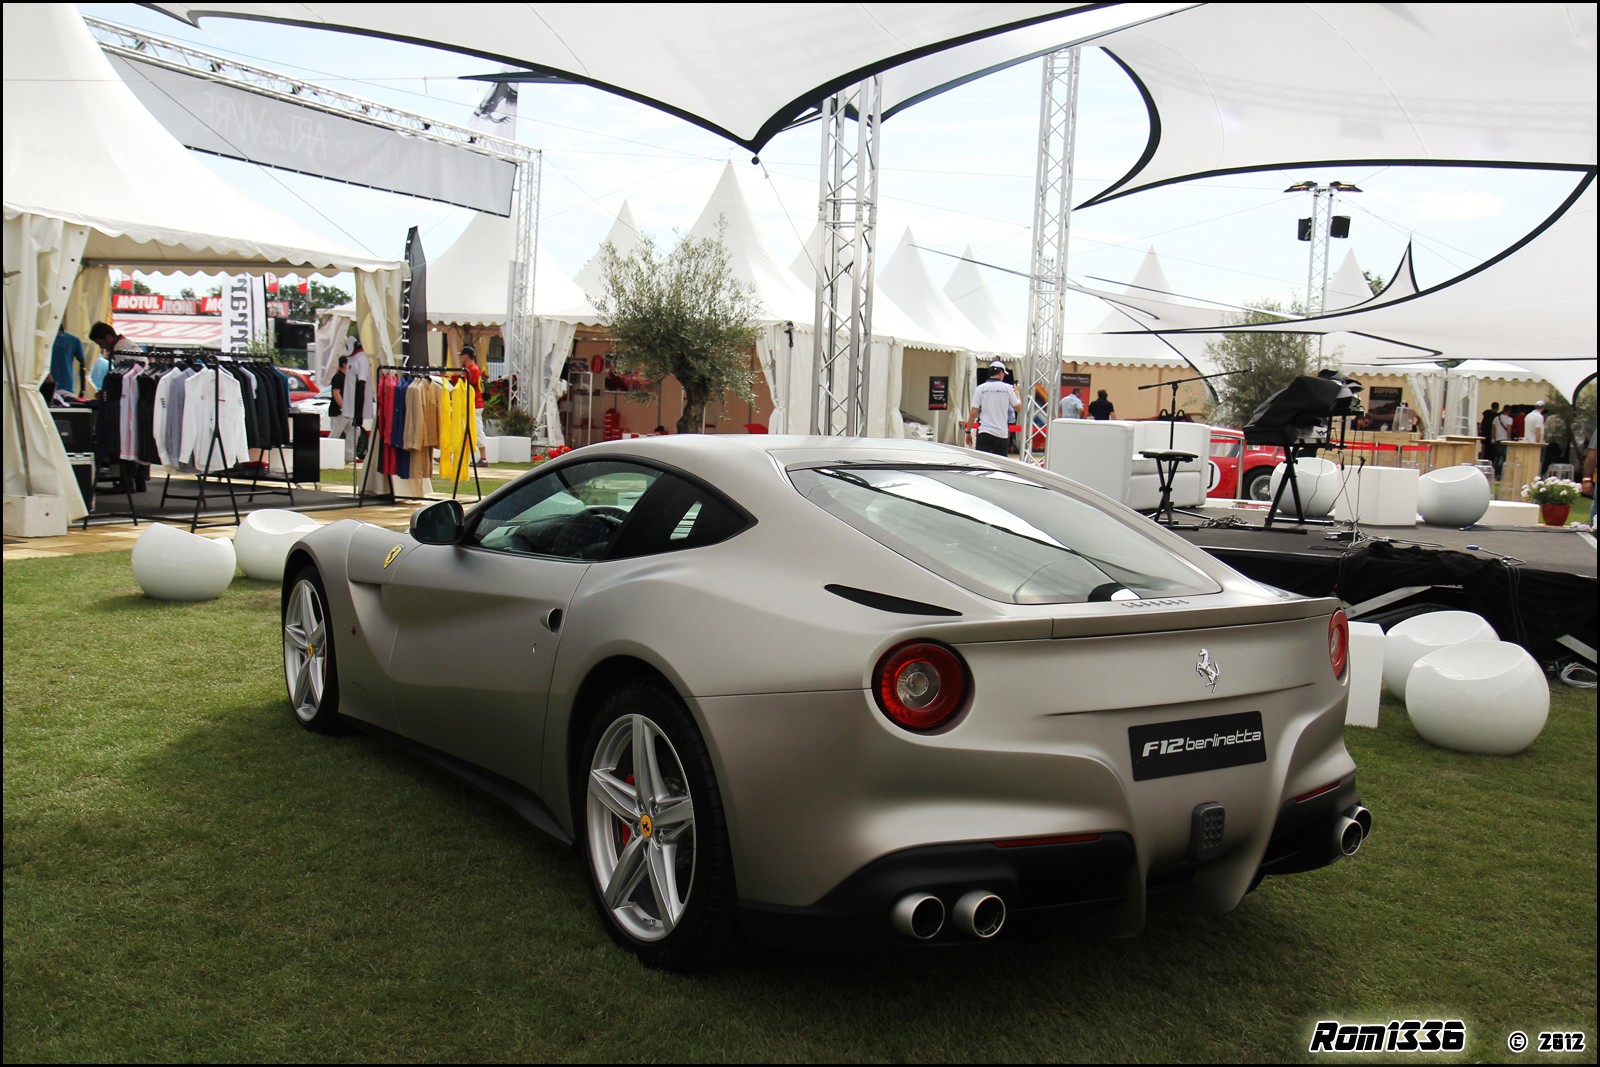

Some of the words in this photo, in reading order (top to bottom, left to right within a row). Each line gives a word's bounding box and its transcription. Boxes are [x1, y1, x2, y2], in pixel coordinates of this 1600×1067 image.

[116, 295, 160, 309] MOTUL
[1142, 738, 1184, 757] F12
[1185, 729, 1261, 751] berlinetta
